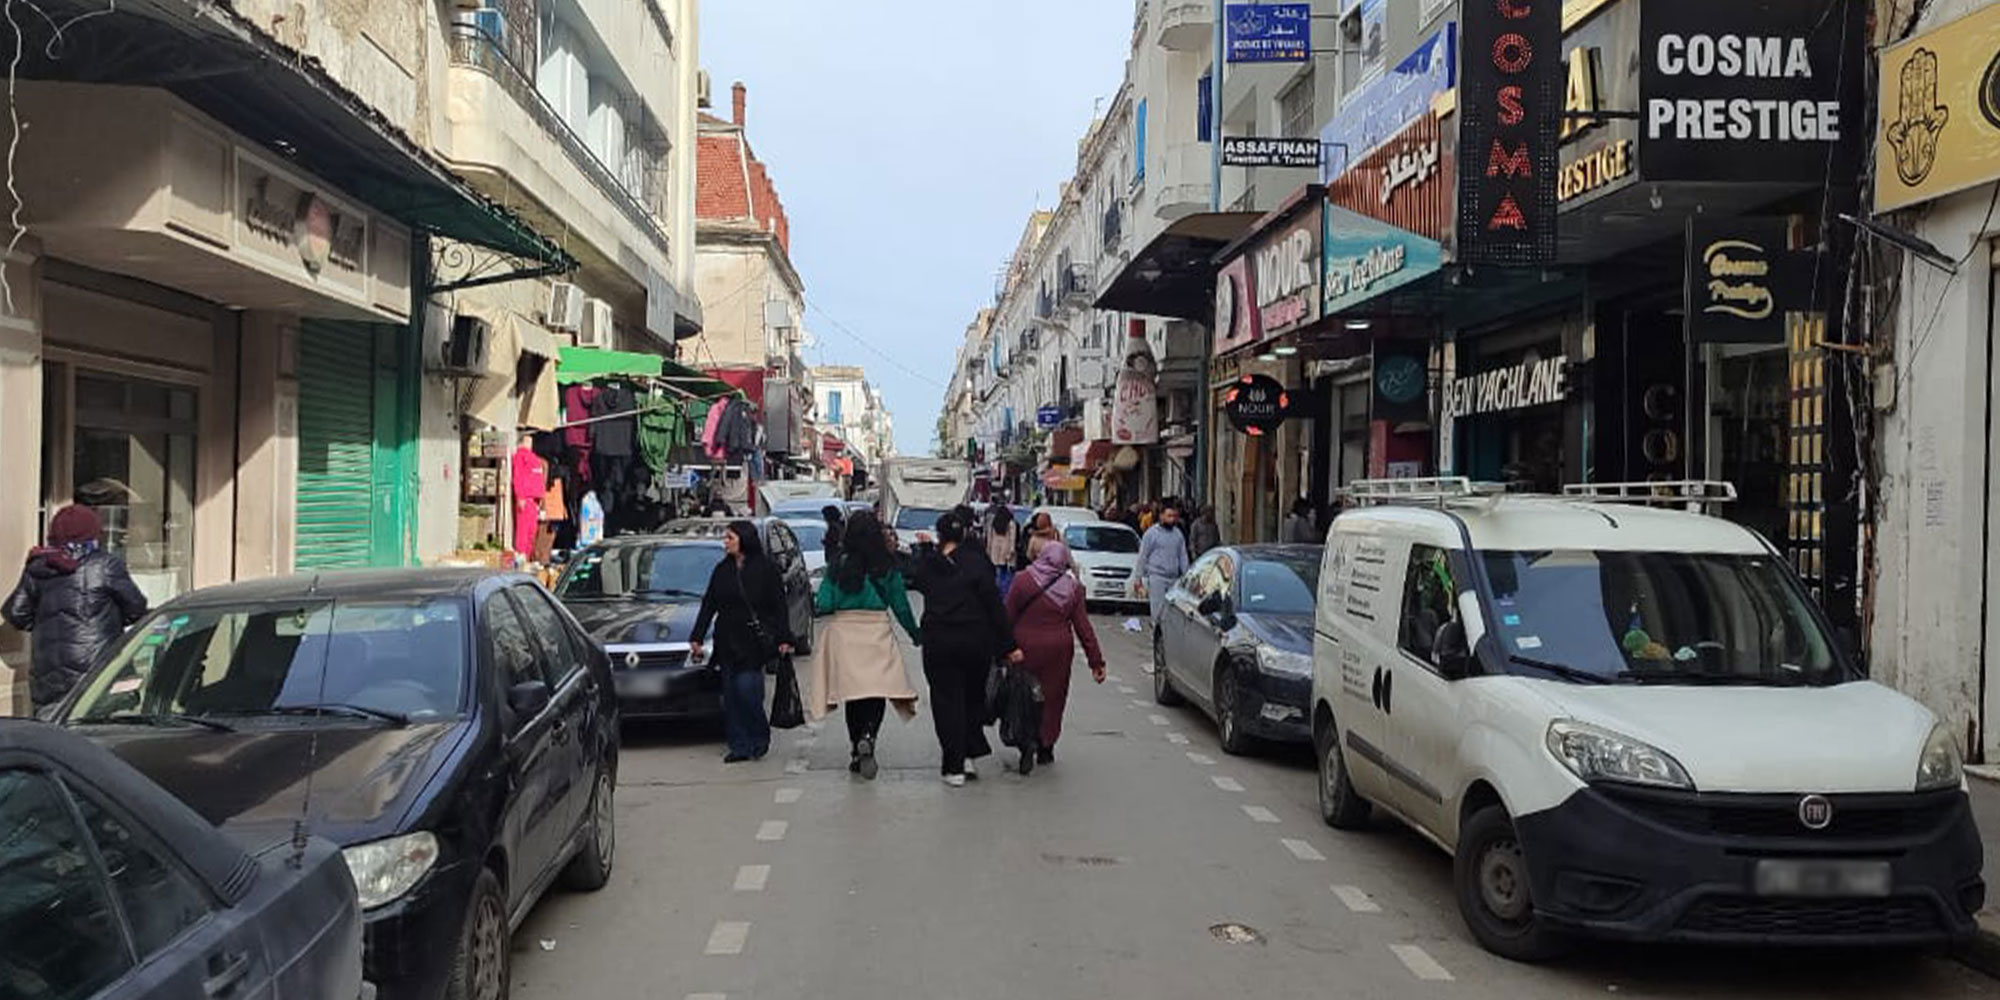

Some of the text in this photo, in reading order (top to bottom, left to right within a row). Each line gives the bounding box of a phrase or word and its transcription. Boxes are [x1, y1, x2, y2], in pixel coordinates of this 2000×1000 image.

[1657, 34, 1812, 78] COSMA
[1648, 98, 1840, 141] PRESTIGE
[1225, 141, 1318, 155] ASSAFINAH
[1254, 228, 1312, 308] NOUR
[1442, 377, 1475, 418] BEN
[1475, 355, 1568, 413] YAGHLANE
[1238, 402, 1276, 415] NOUR
